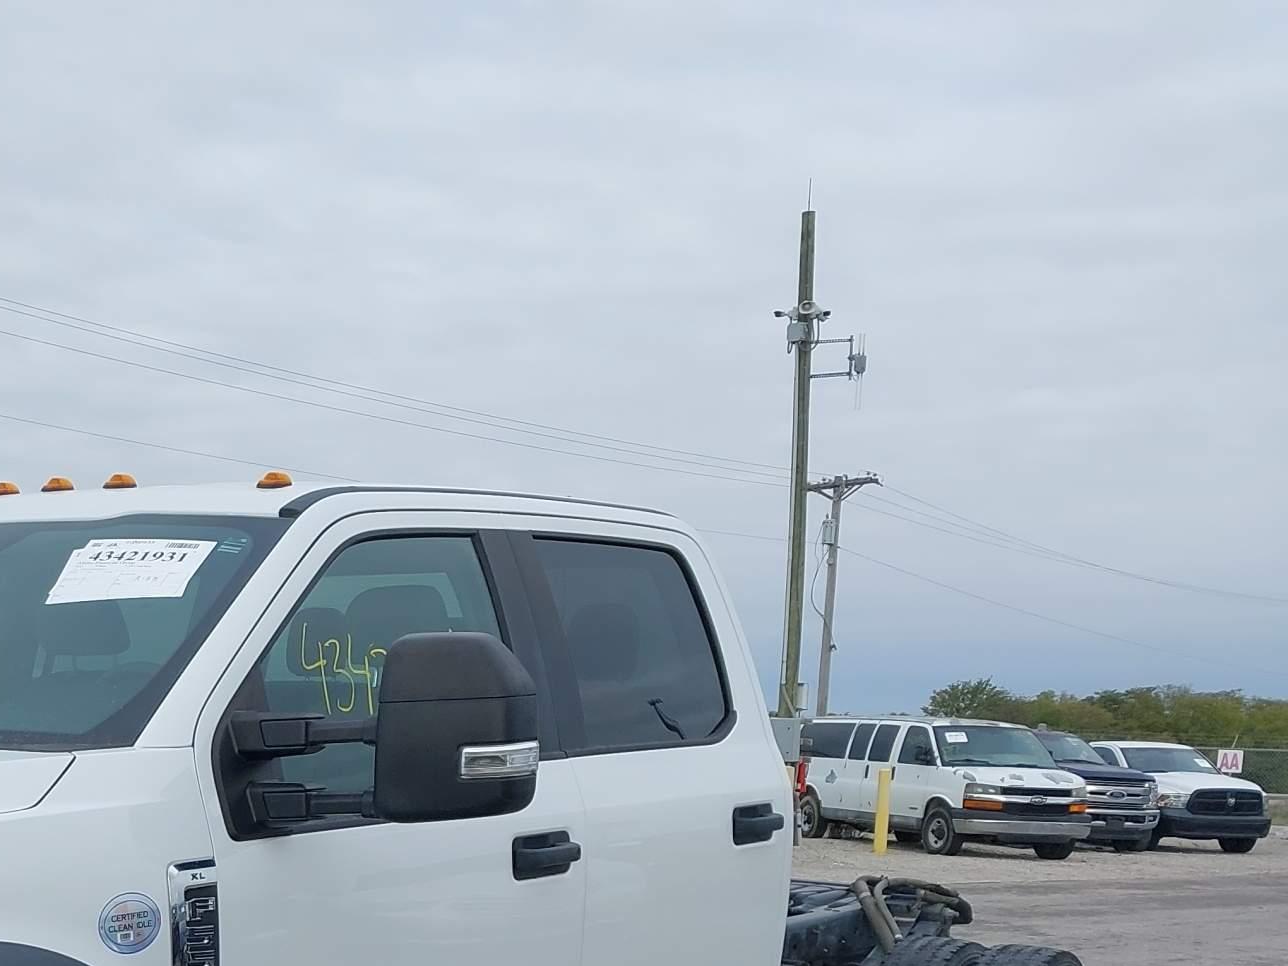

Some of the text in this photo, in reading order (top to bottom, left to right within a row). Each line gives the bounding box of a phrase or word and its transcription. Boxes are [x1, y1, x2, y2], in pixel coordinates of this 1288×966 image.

[88, 550, 188, 563] 43421931
[190, 872, 206, 881] XL
[110, 910, 149, 923] CERTIFIED
[108, 919, 153, 933] CLEAN IDLE
